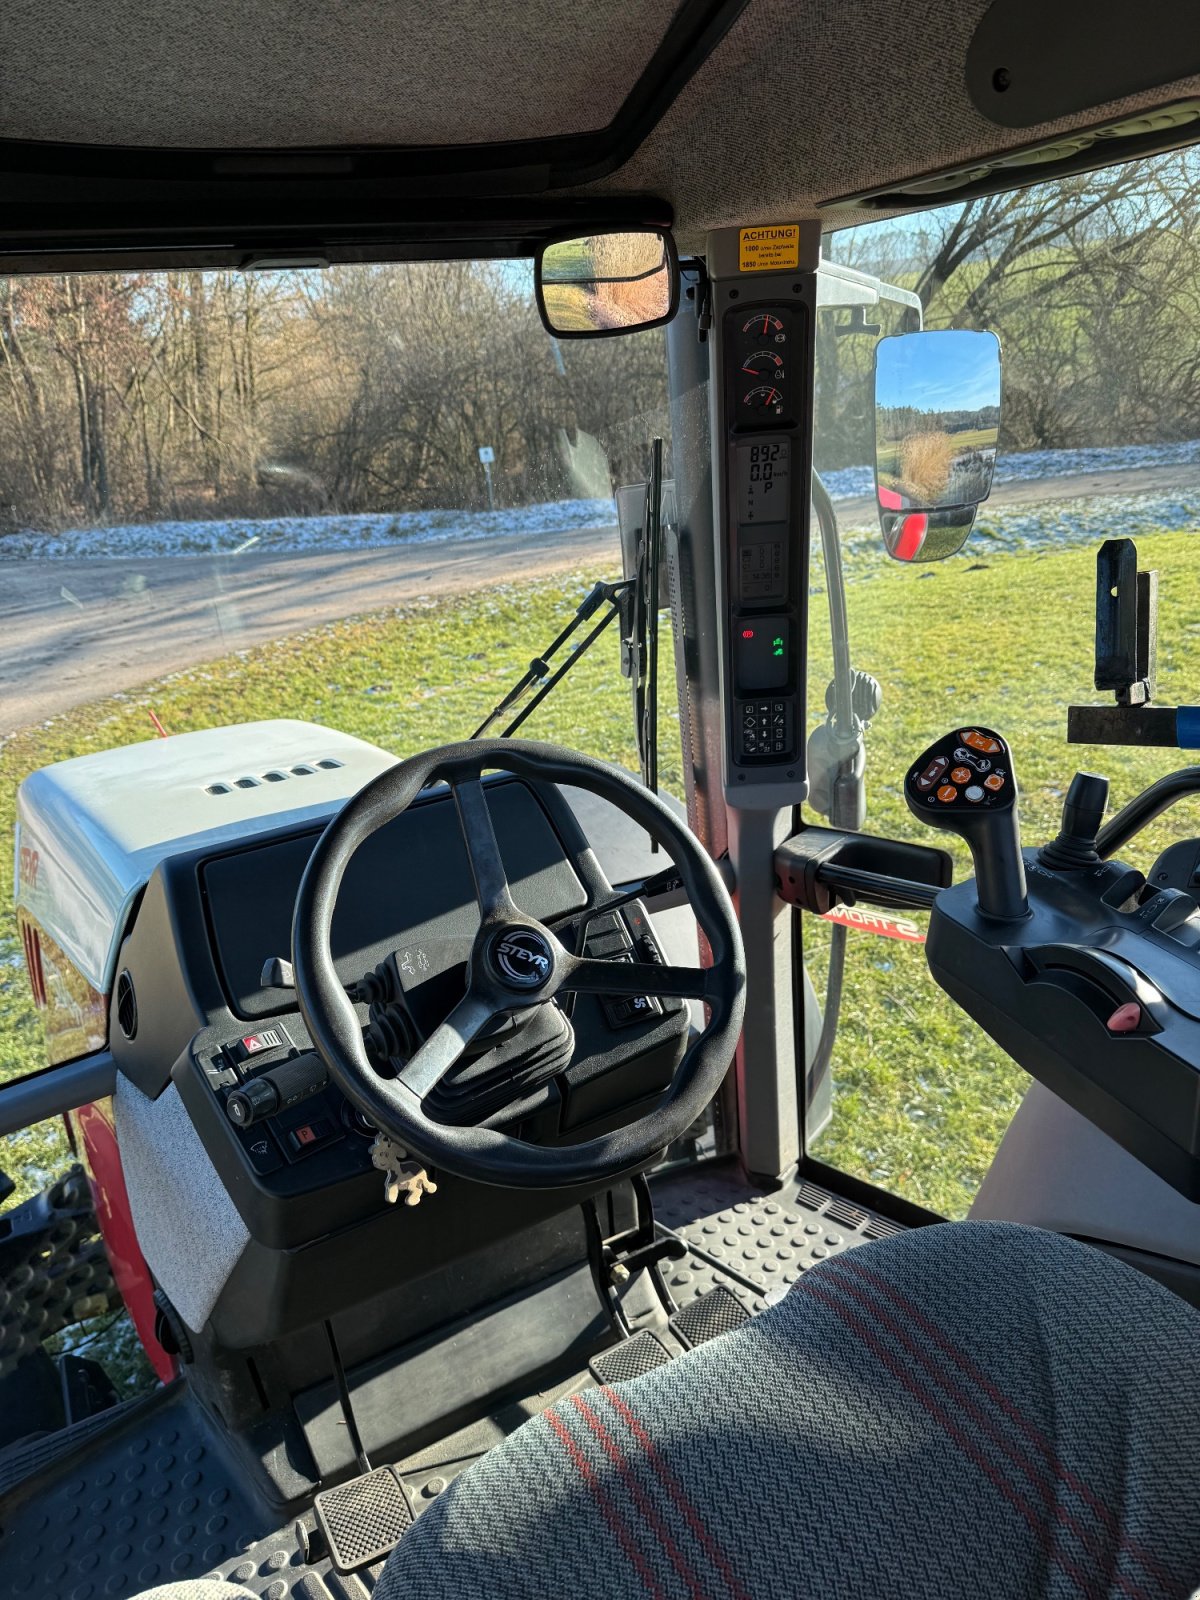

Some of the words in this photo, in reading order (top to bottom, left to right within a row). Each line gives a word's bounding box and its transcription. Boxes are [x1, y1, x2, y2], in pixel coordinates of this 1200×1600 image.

[743, 229, 796, 241] ACHTUNG!
[750, 444, 780, 463] 892
[764, 481, 773, 494] P
[496, 942, 549, 969] STEYR
[301, 1130, 309, 1141] P
